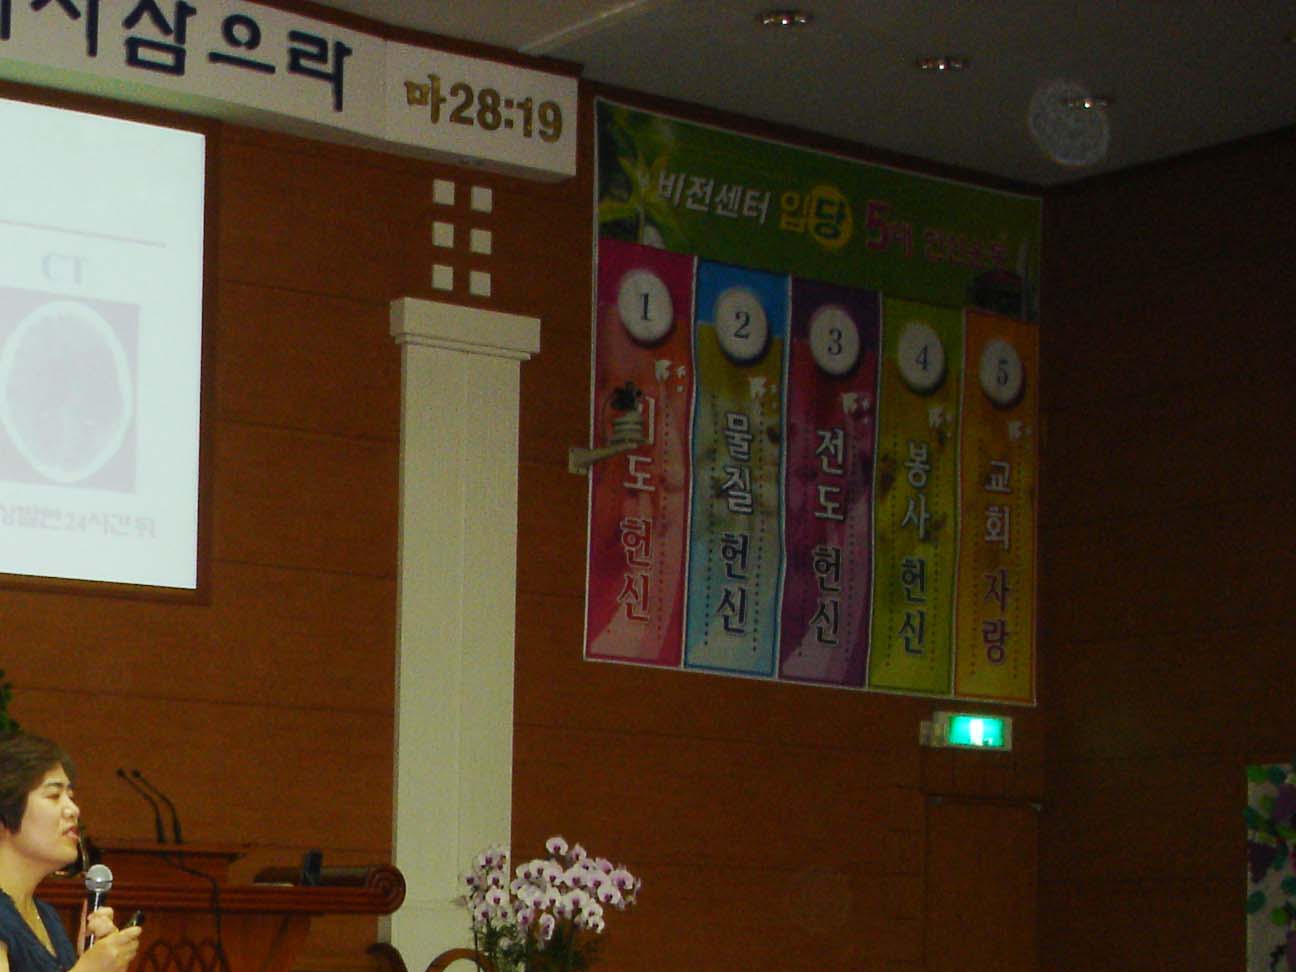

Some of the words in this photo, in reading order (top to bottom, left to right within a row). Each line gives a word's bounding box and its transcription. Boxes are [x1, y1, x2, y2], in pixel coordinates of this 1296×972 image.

[405, 74, 563, 144] 마28:19
[657, 171, 771, 225] 비전센터
[41, 250, 90, 287] CT
[639, 292, 652, 321] 1
[733, 311, 751, 339] 2
[827, 328, 844, 356] 3
[915, 344, 929, 371] 4
[995, 359, 1010, 386] 5
[721, 412, 754, 515] 물질
[814, 428, 845, 522] 전도
[900, 438, 931, 540] 봉사
[983, 460, 1013, 552] 교회
[616, 516, 654, 622] 헌신
[717, 533, 750, 636] 헌신
[809, 547, 843, 647] 헌신
[897, 559, 927, 655] 헌신
